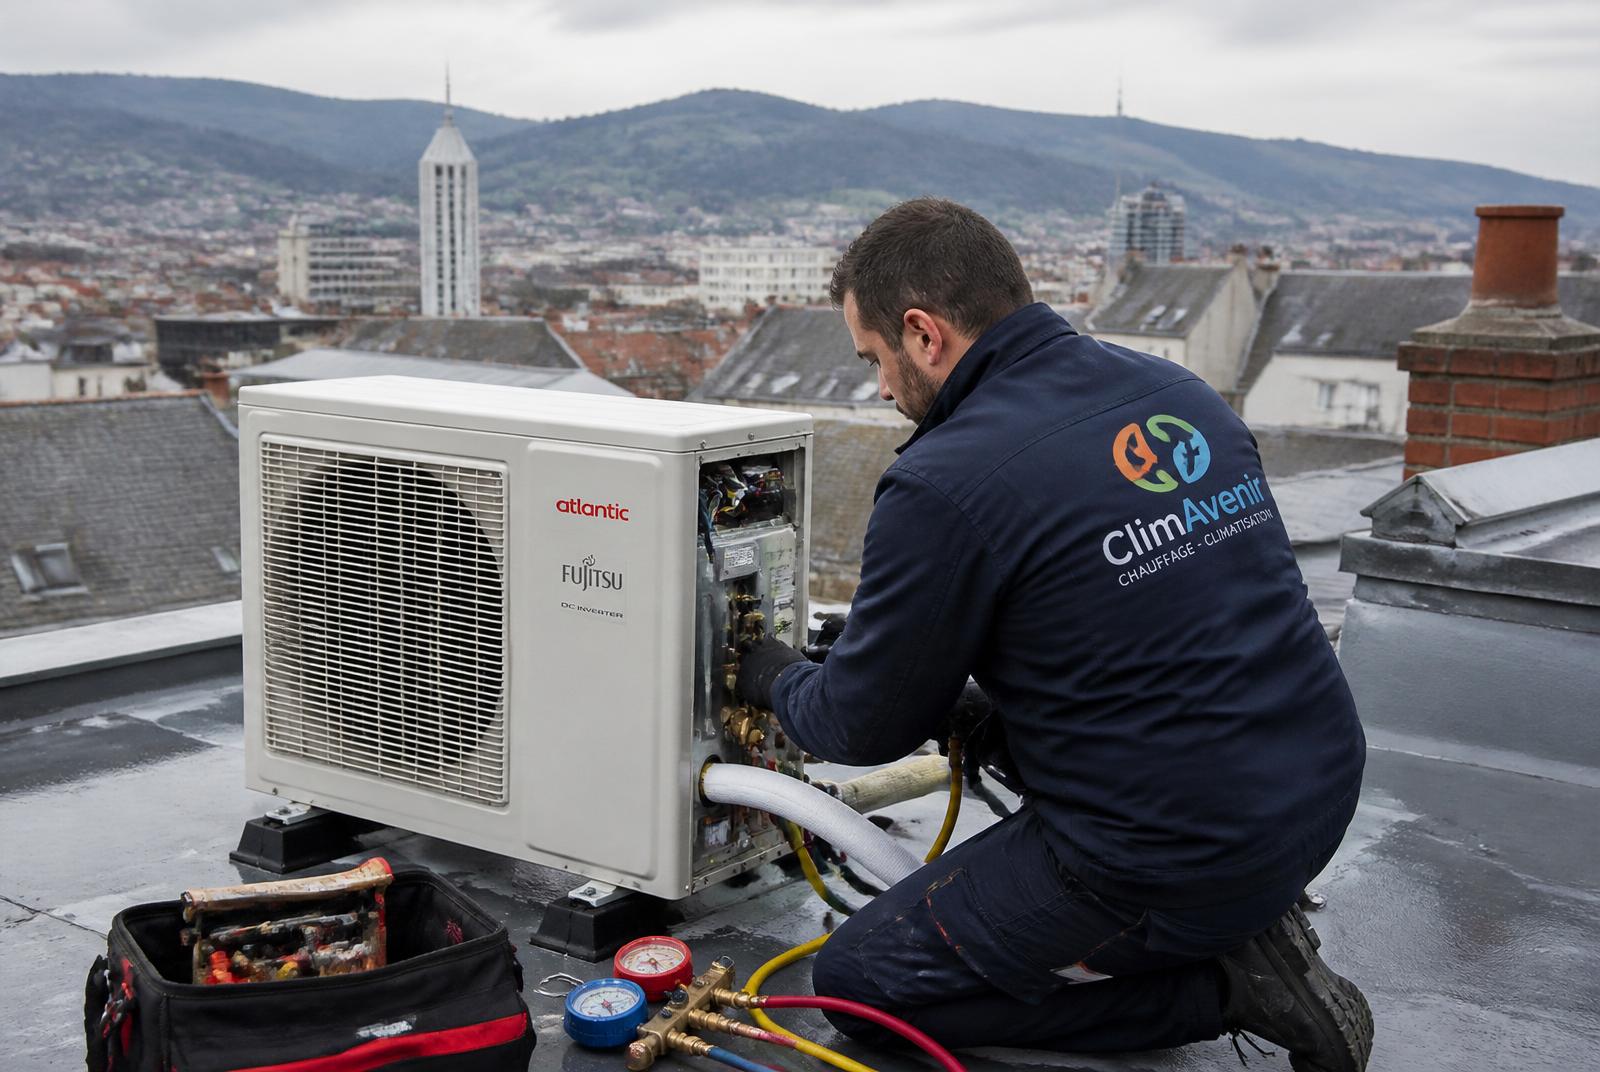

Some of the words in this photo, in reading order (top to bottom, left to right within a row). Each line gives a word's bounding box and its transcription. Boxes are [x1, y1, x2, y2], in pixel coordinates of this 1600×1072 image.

[556, 498, 629, 521] atlantic
[1102, 474, 1264, 566] ClimAvenir
[562, 564, 623, 591] FUJITSU
[1118, 542, 1195, 587] CHAUFFAGE
[561, 602, 576, 610] DC
